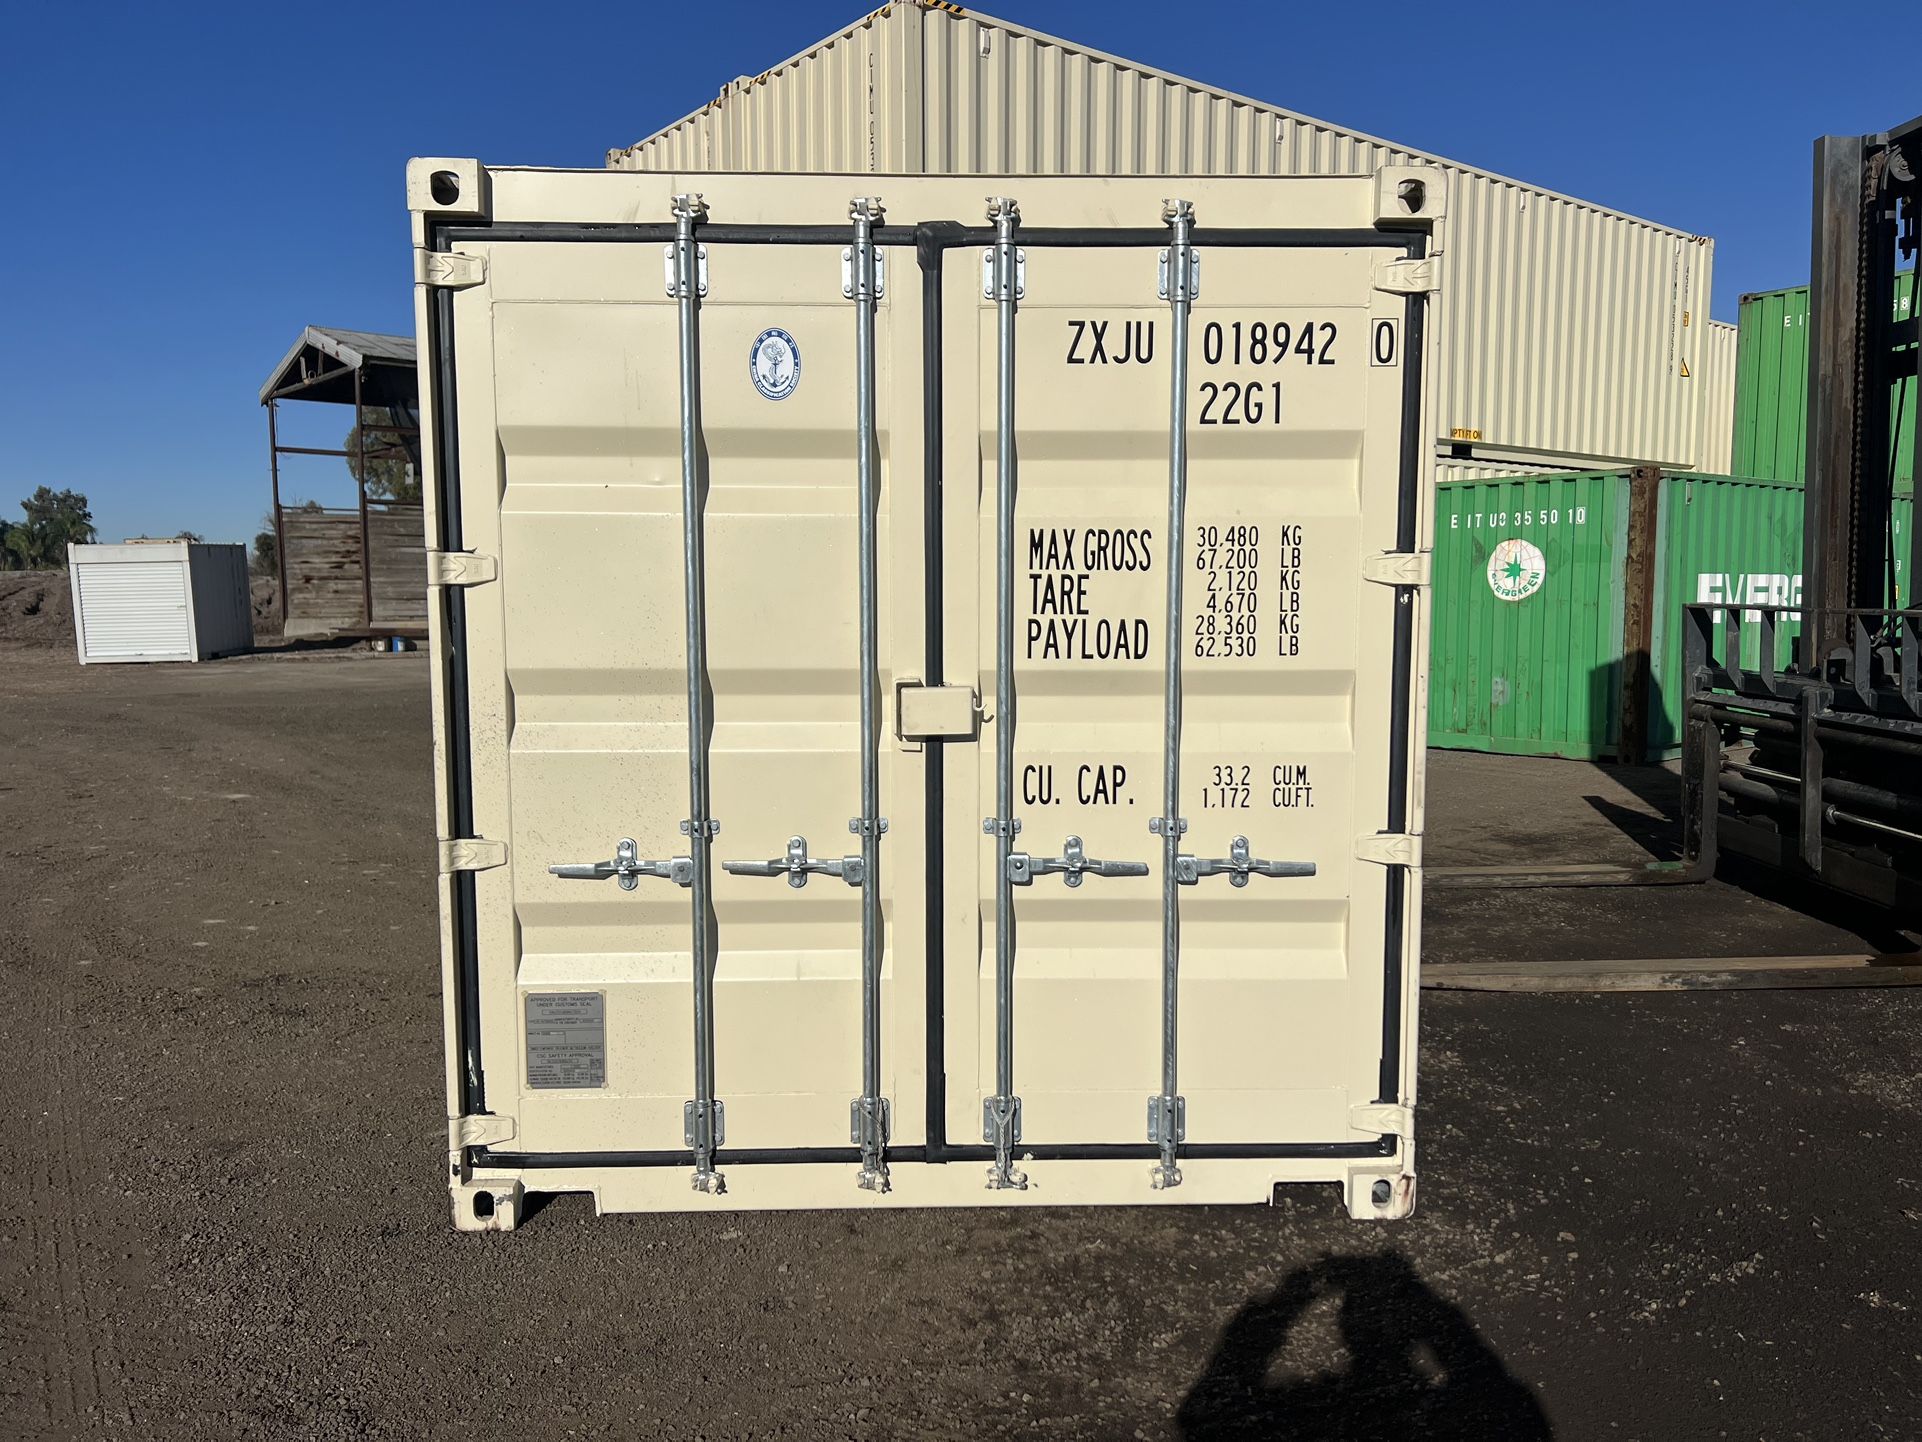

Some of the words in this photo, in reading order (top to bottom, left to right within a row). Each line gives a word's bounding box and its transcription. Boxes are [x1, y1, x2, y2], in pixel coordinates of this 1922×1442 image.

[1067, 321, 1154, 365] ZXJU
[1204, 321, 1337, 365] 018942
[1375, 321, 1395, 364] 0
[1199, 381, 1281, 425] 22G1
[1197, 525, 1259, 548] 30,480
[1281, 524, 1302, 547] KG
[1029, 528, 1076, 571] MAX
[1083, 528, 1152, 572] GROSS
[1196, 548, 1258, 570] 67,200
[1281, 547, 1301, 569] LB
[1206, 570, 1258, 592] 2,120
[1280, 569, 1301, 591] KG
[1029, 573, 1090, 615] TARE
[1206, 592, 1258, 614] 4,670
[1279, 591, 1300, 613] LB
[1195, 614, 1257, 636] 28,360
[1279, 613, 1300, 635] KG
[1027, 618, 1149, 660] PAYLOAD
[1195, 636, 1257, 657] 62,530
[1278, 635, 1299, 656] LB
[1023, 764, 1060, 805] CU.
[1077, 764, 1134, 805] CAP.
[1213, 765, 1251, 786] 33.2
[1273, 765, 1310, 786] CU.M.
[1202, 787, 1250, 809] 1,172
[1273, 787, 1314, 808] CU.FT.
